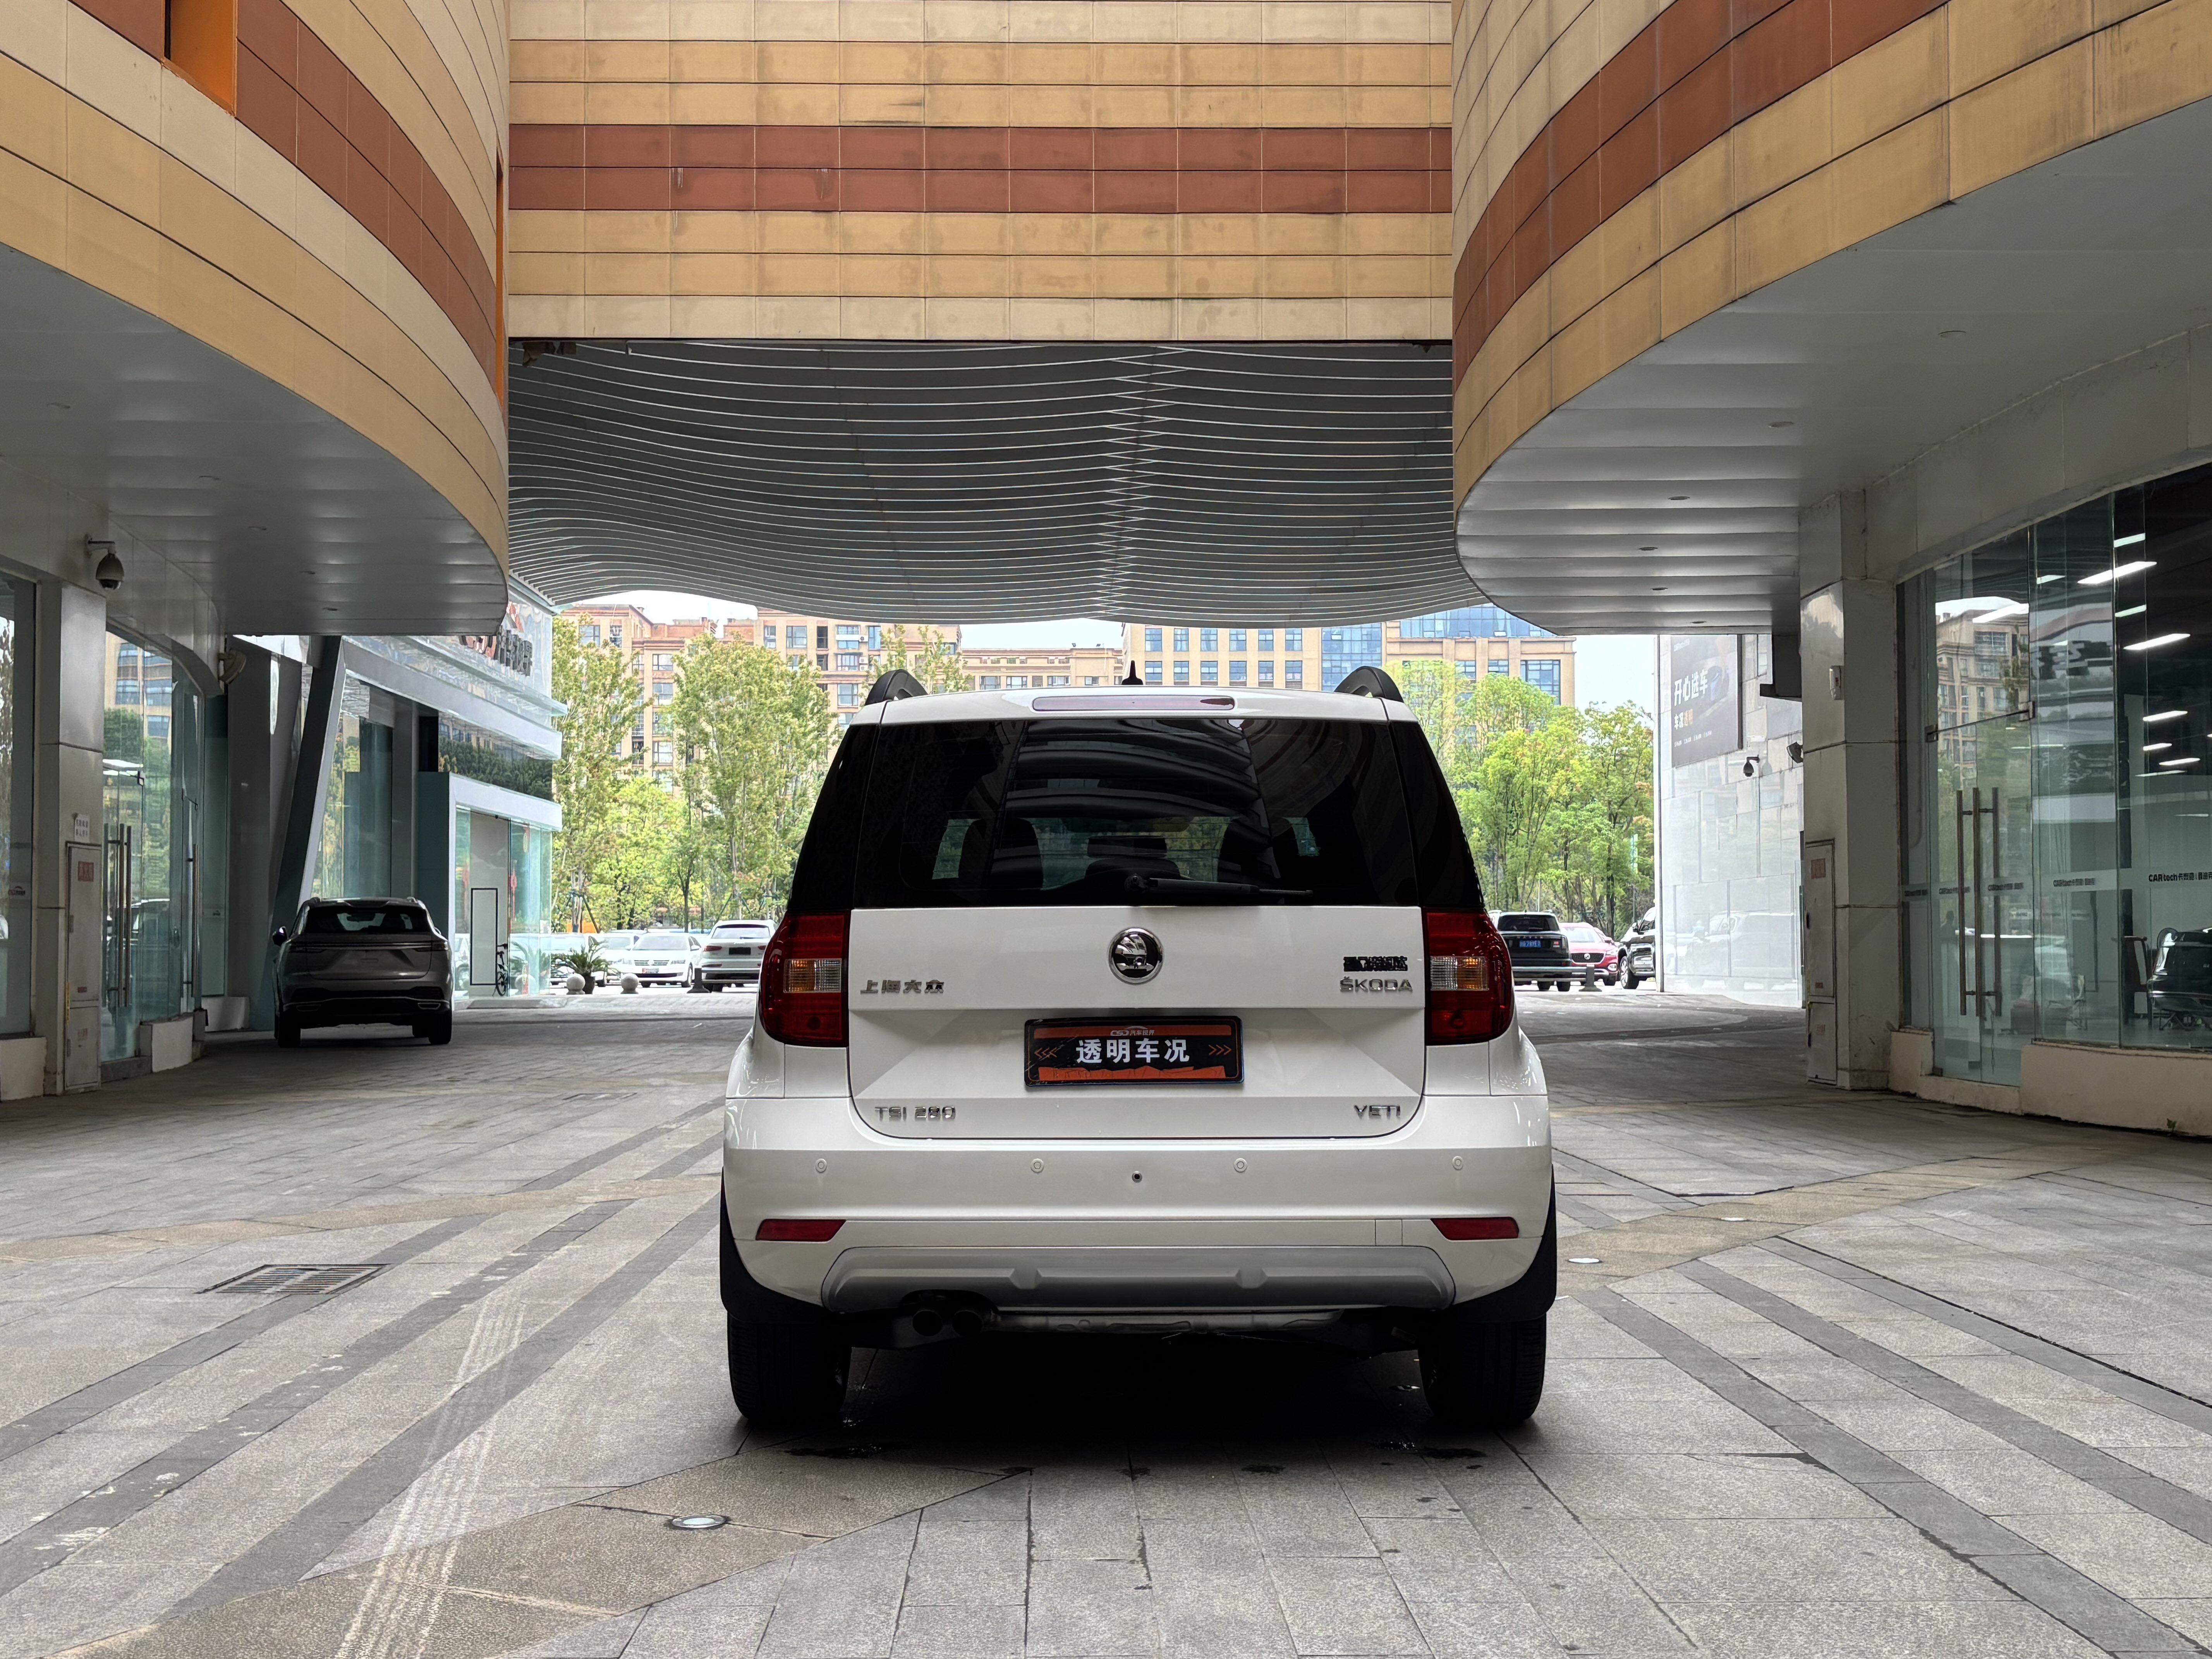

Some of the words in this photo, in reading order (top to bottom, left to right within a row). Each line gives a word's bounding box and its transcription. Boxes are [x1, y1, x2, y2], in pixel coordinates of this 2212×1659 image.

[1674, 669, 1708, 706] 开心选车
[2148, 873, 2178, 882] CARtech
[860, 979, 945, 994] 上海大众
[1340, 976, 1413, 992] ŠKODA
[1076, 1038, 1190, 1063] 透明车况
[874, 1106, 907, 1121] TSI
[914, 1106, 956, 1121] 280
[1354, 1104, 1401, 1119] YETI
